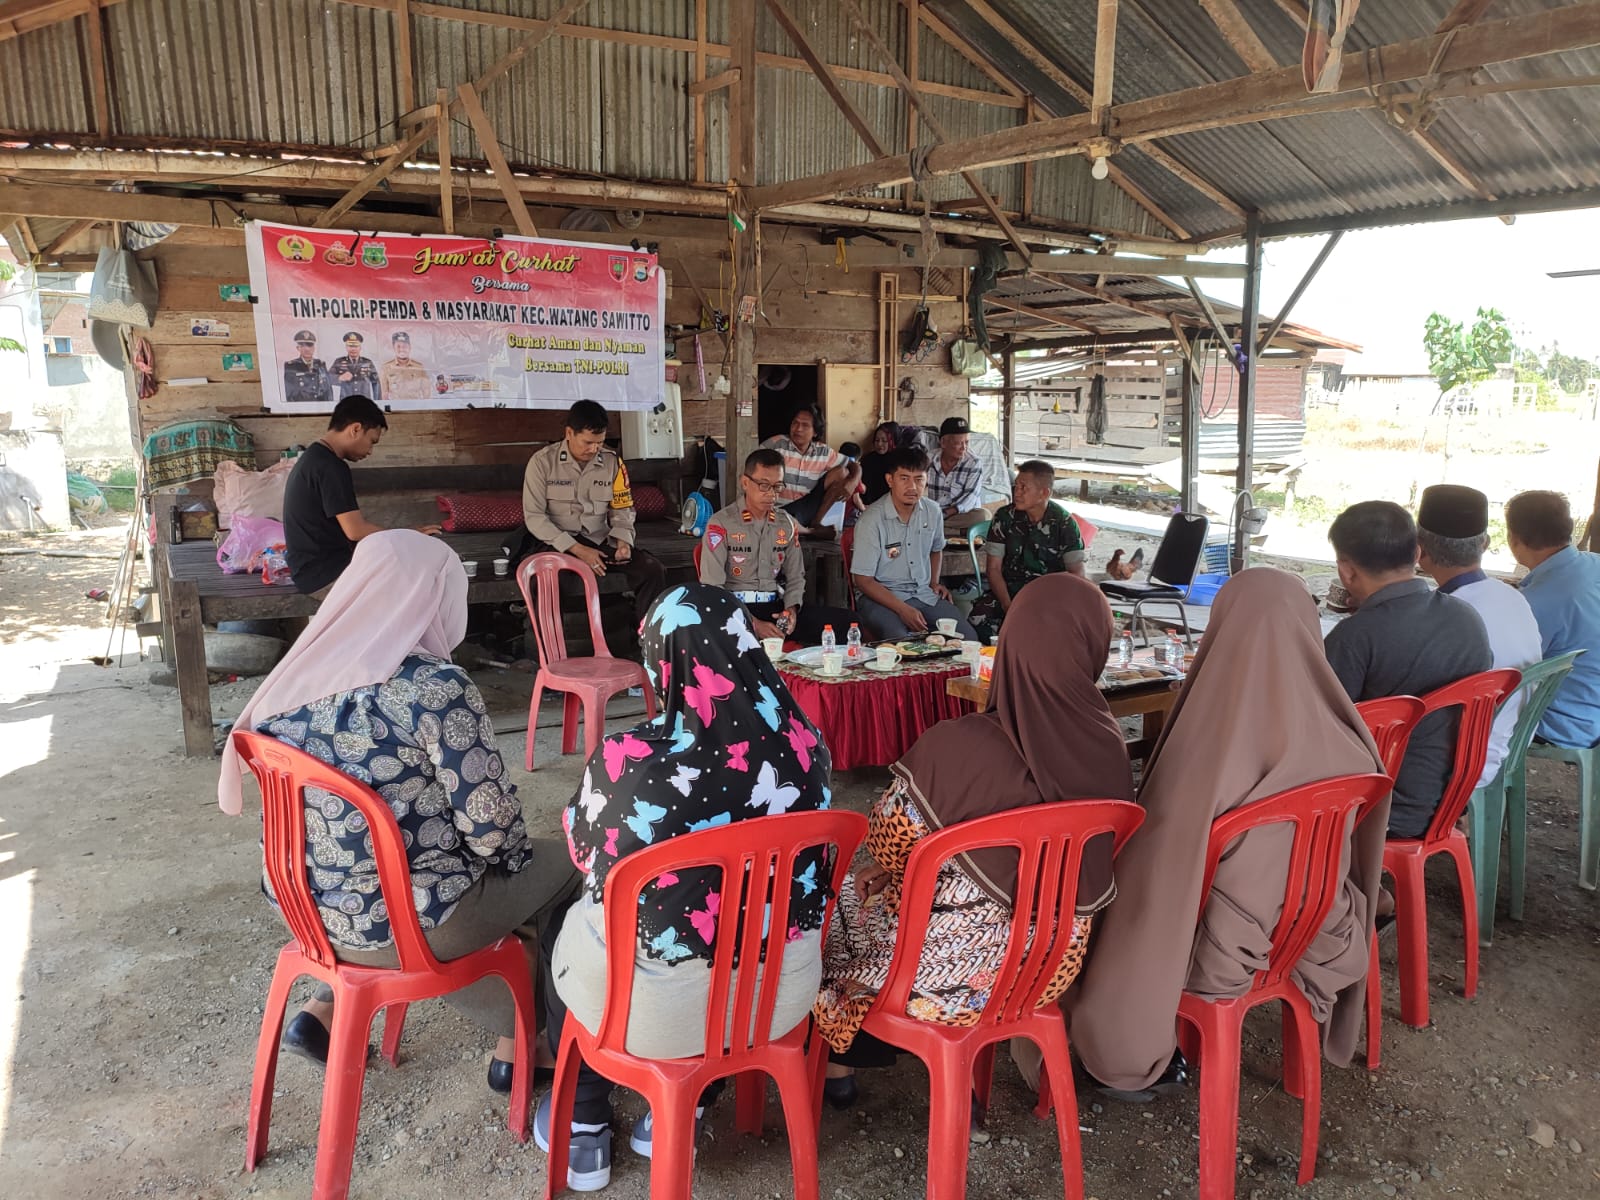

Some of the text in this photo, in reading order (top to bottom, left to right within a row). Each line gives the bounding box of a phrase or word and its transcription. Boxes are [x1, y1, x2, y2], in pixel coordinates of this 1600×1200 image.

[412, 247, 580, 274] Jum'at Curhat
[472, 275, 531, 294] Bersama
[290, 298, 650, 331] TNI-POLRI-PEMDA & MASYARAKAT KEC.WATANG SAWITTO
[508, 333, 645, 354] Curhat Aman dan Nyaman
[525, 358, 629, 375] Bersama TNI-POLRI
